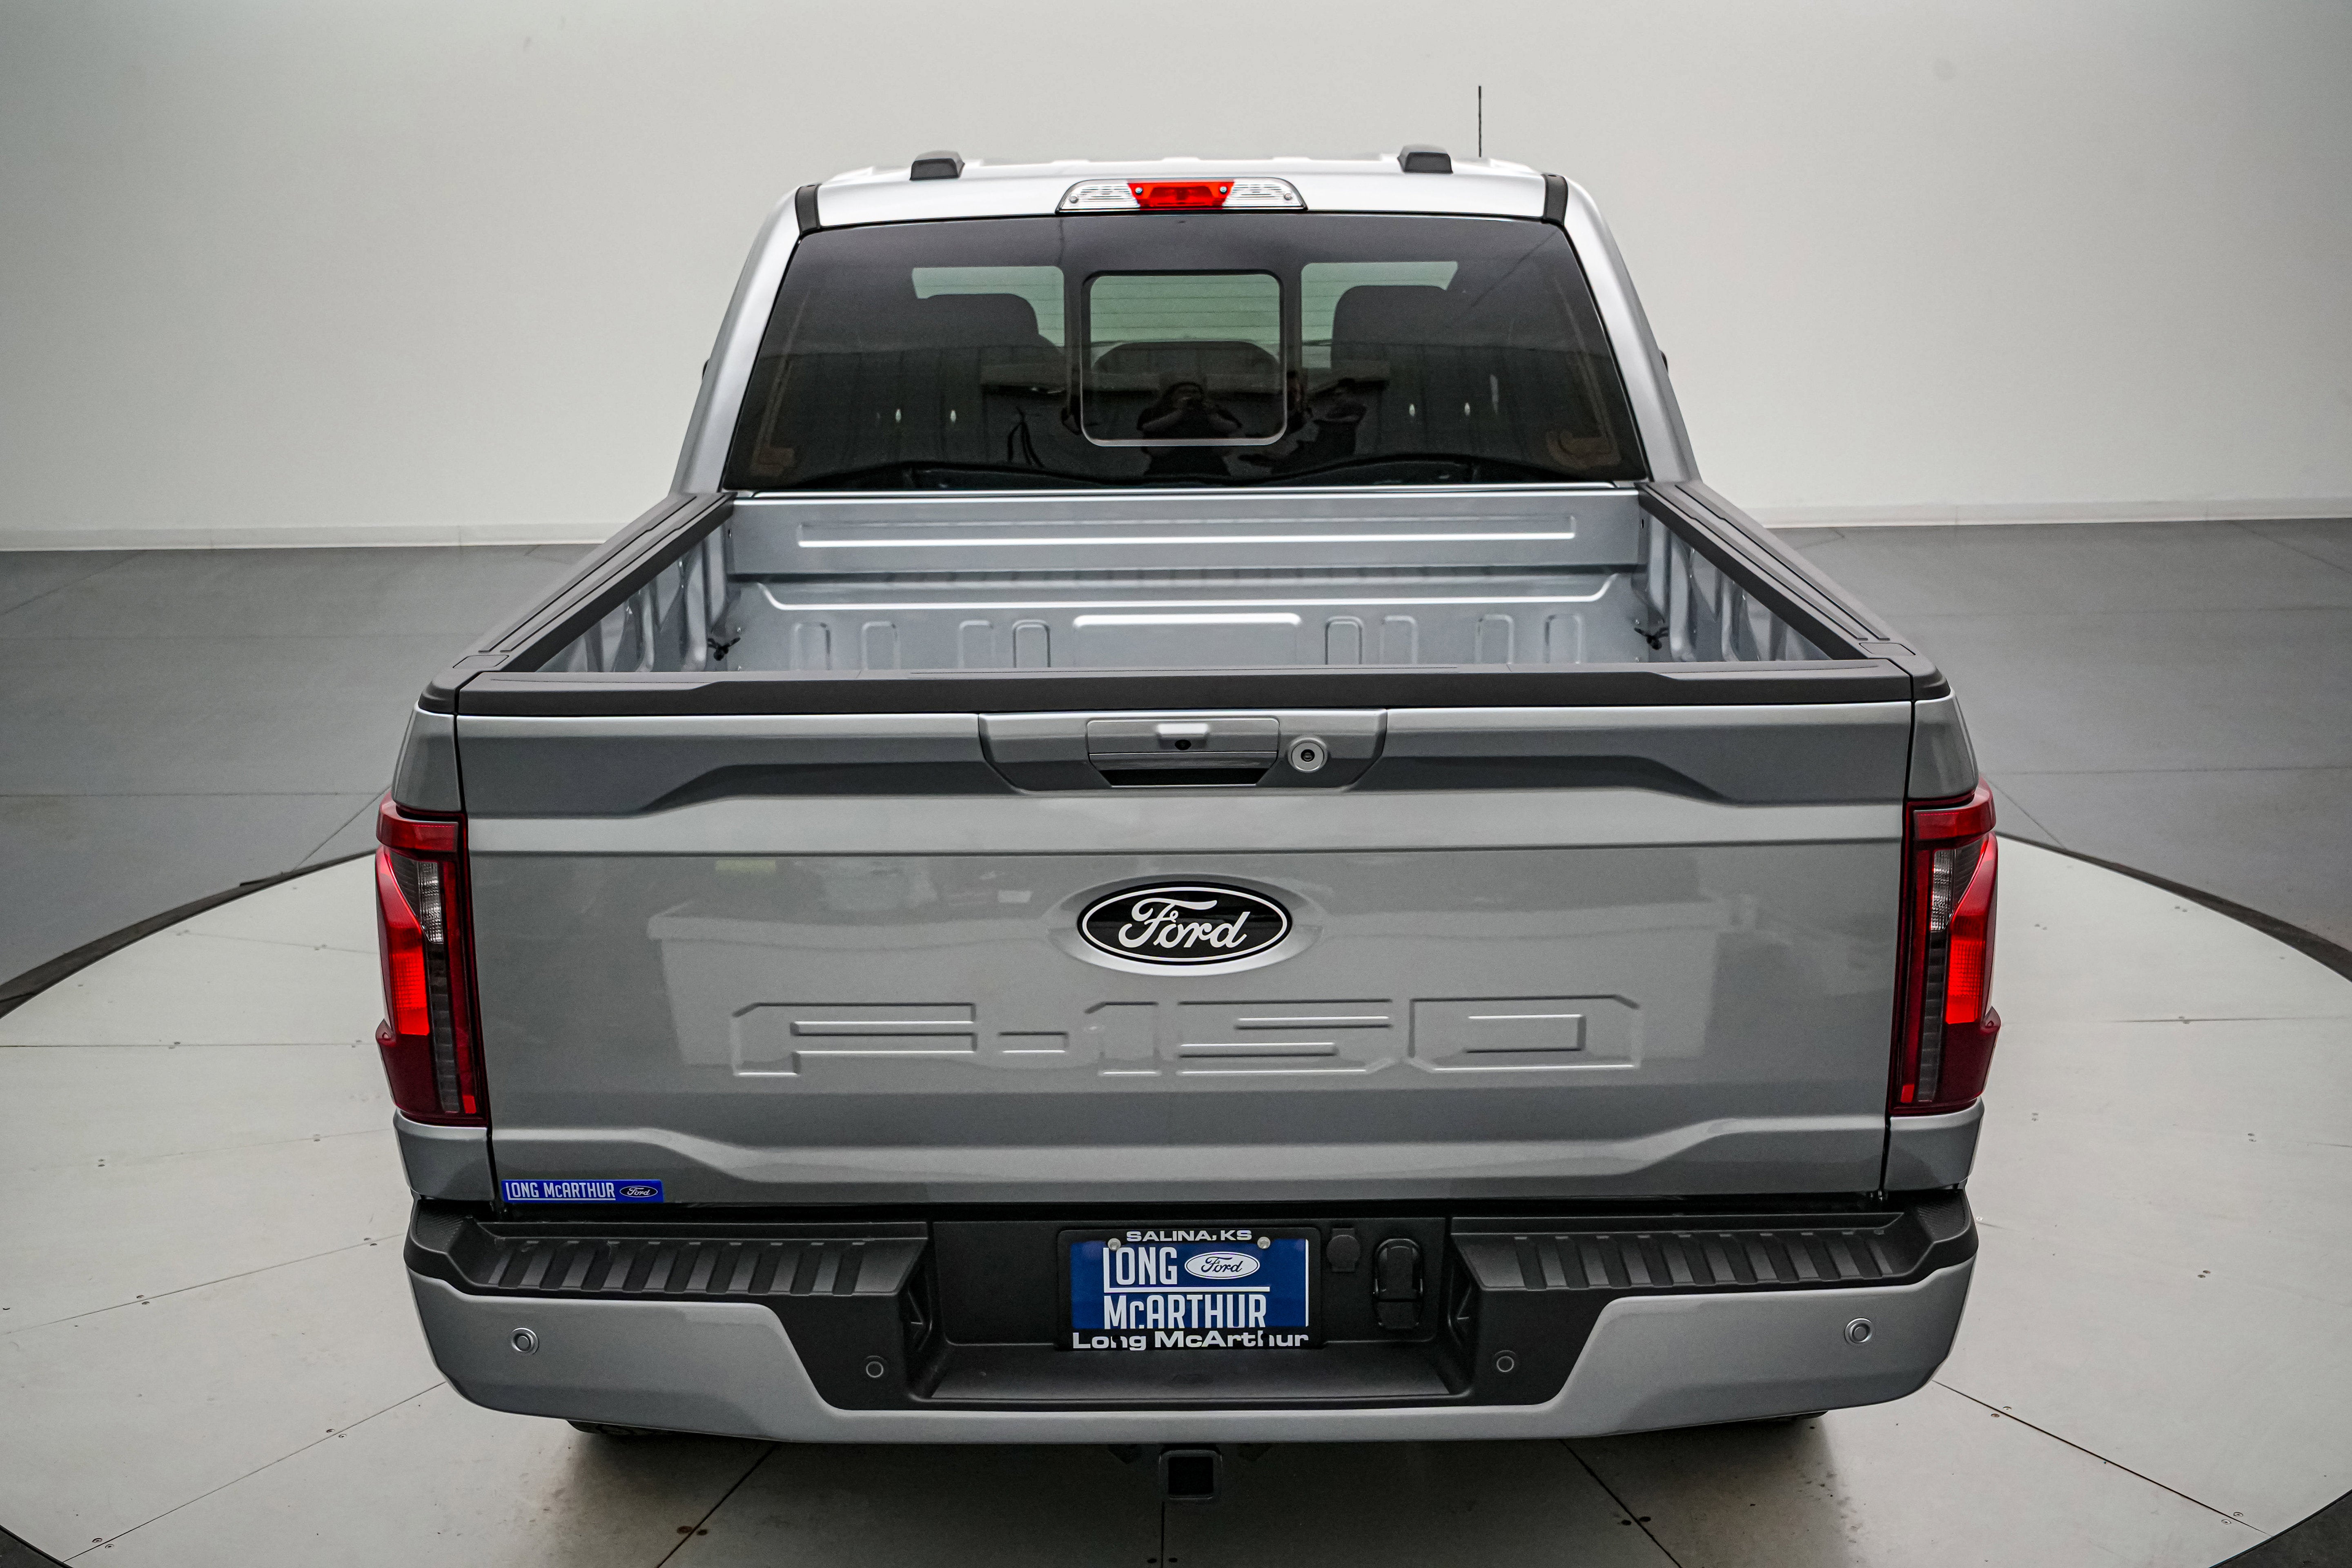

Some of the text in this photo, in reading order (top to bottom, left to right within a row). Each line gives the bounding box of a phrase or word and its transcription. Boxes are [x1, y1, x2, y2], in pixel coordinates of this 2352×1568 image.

[1118, 898, 1251, 949] Ford
[506, 1182, 615, 1200] LONG McARTHUR
[626, 1187, 650, 1196] Ford
[1126, 1229, 1252, 1242] SALINA, KS
[1103, 1247, 1178, 1293] LONG
[1200, 1256, 1243, 1273] Ford
[1104, 1294, 1266, 1329] McARTHUR
[1073, 1330, 1309, 1351] Long McArthur
